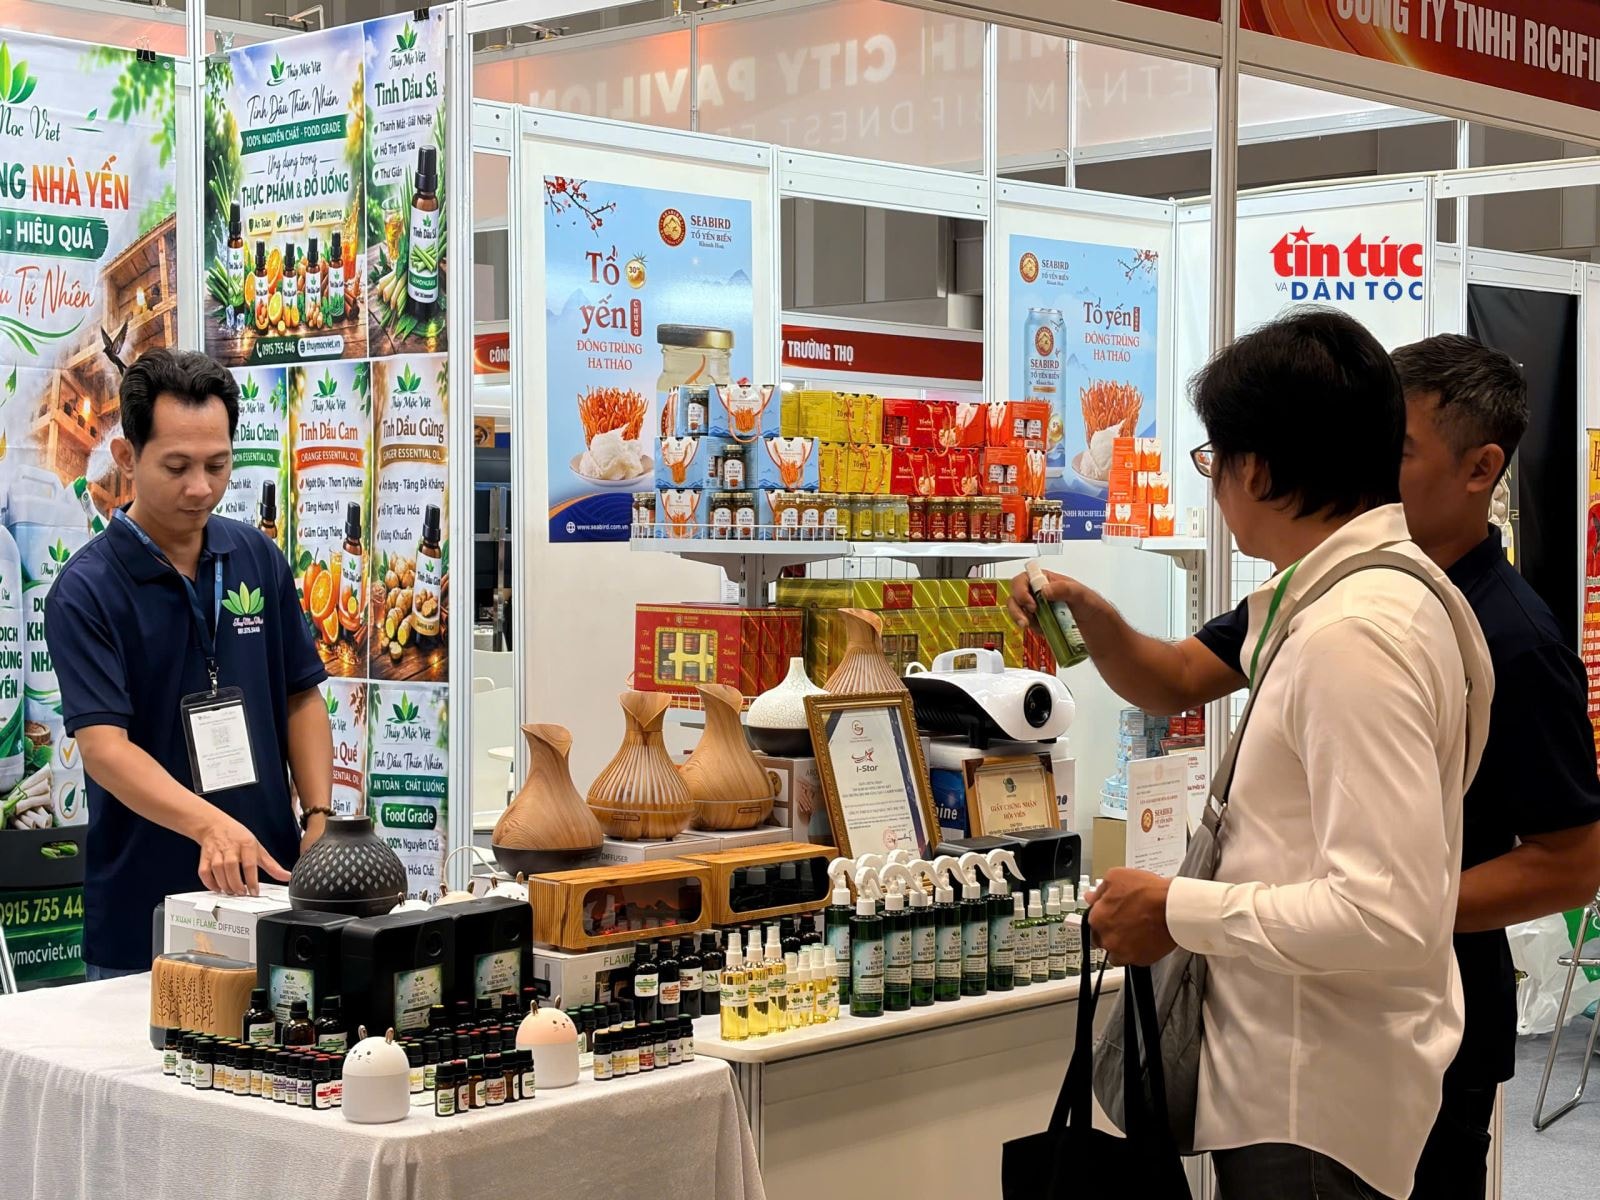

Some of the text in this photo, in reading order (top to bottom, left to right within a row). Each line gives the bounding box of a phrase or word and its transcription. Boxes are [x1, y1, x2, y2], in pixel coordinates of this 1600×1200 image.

[1420, 0, 1446, 42] TY
[1453, 3, 1516, 61] TNHH
[374, 82, 400, 107] Tinh
[246, 134, 262, 148] 100%
[304, 122, 320, 138] FOOD
[322, 120, 342, 135] GRADE
[32, 157, 81, 206] NHÀ
[85, 154, 129, 210] YẾN
[296, 184, 302, 200] &
[690, 214, 732, 230] SEABIRD
[1269, 225, 1423, 278] tin tức
[1041, 260, 1070, 270] SEABIRD
[41, 264, 95, 319] Nhiên
[1291, 278, 1354, 300] DÂN
[1365, 278, 1423, 304] TỘC
[580, 294, 628, 334] yến
[1105, 303, 1131, 328] yến
[262, 341, 296, 356] 0915 755 446
[608, 340, 643, 355] TRÙNG
[787, 338, 854, 366] TRƯỜNG THỌ
[1030, 358, 1060, 370] SEABIRD
[256, 422, 279, 442] Chanh
[300, 422, 318, 441] Tinh
[338, 422, 358, 440] Cam
[383, 422, 394, 438] Tinh
[419, 418, 444, 444] Gừng
[242, 451, 275, 462] ESSENTIAL OIL
[301, 450, 358, 462] ORANGE ESSENTIAL OIL
[398, 447, 431, 459] ESSENTIAL
[432, 450, 442, 460] OIL
[428, 478, 444, 492] Kháng
[576, 523, 629, 531] www.seabird.com.vn
[339, 740, 358, 764] Quế
[333, 769, 352, 783] SENTIAL
[374, 779, 380, 789] AN
[382, 777, 400, 790] TOÀN
[385, 808, 434, 824] Food Grade
[408, 864, 422, 876] Hóa
[33, 898, 58, 924] 755
[60, 895, 83, 919] 44
[196, 918, 217, 930] FLAME
[218, 922, 250, 936] DIFFUSER
[604, 952, 636, 966] FLAME
